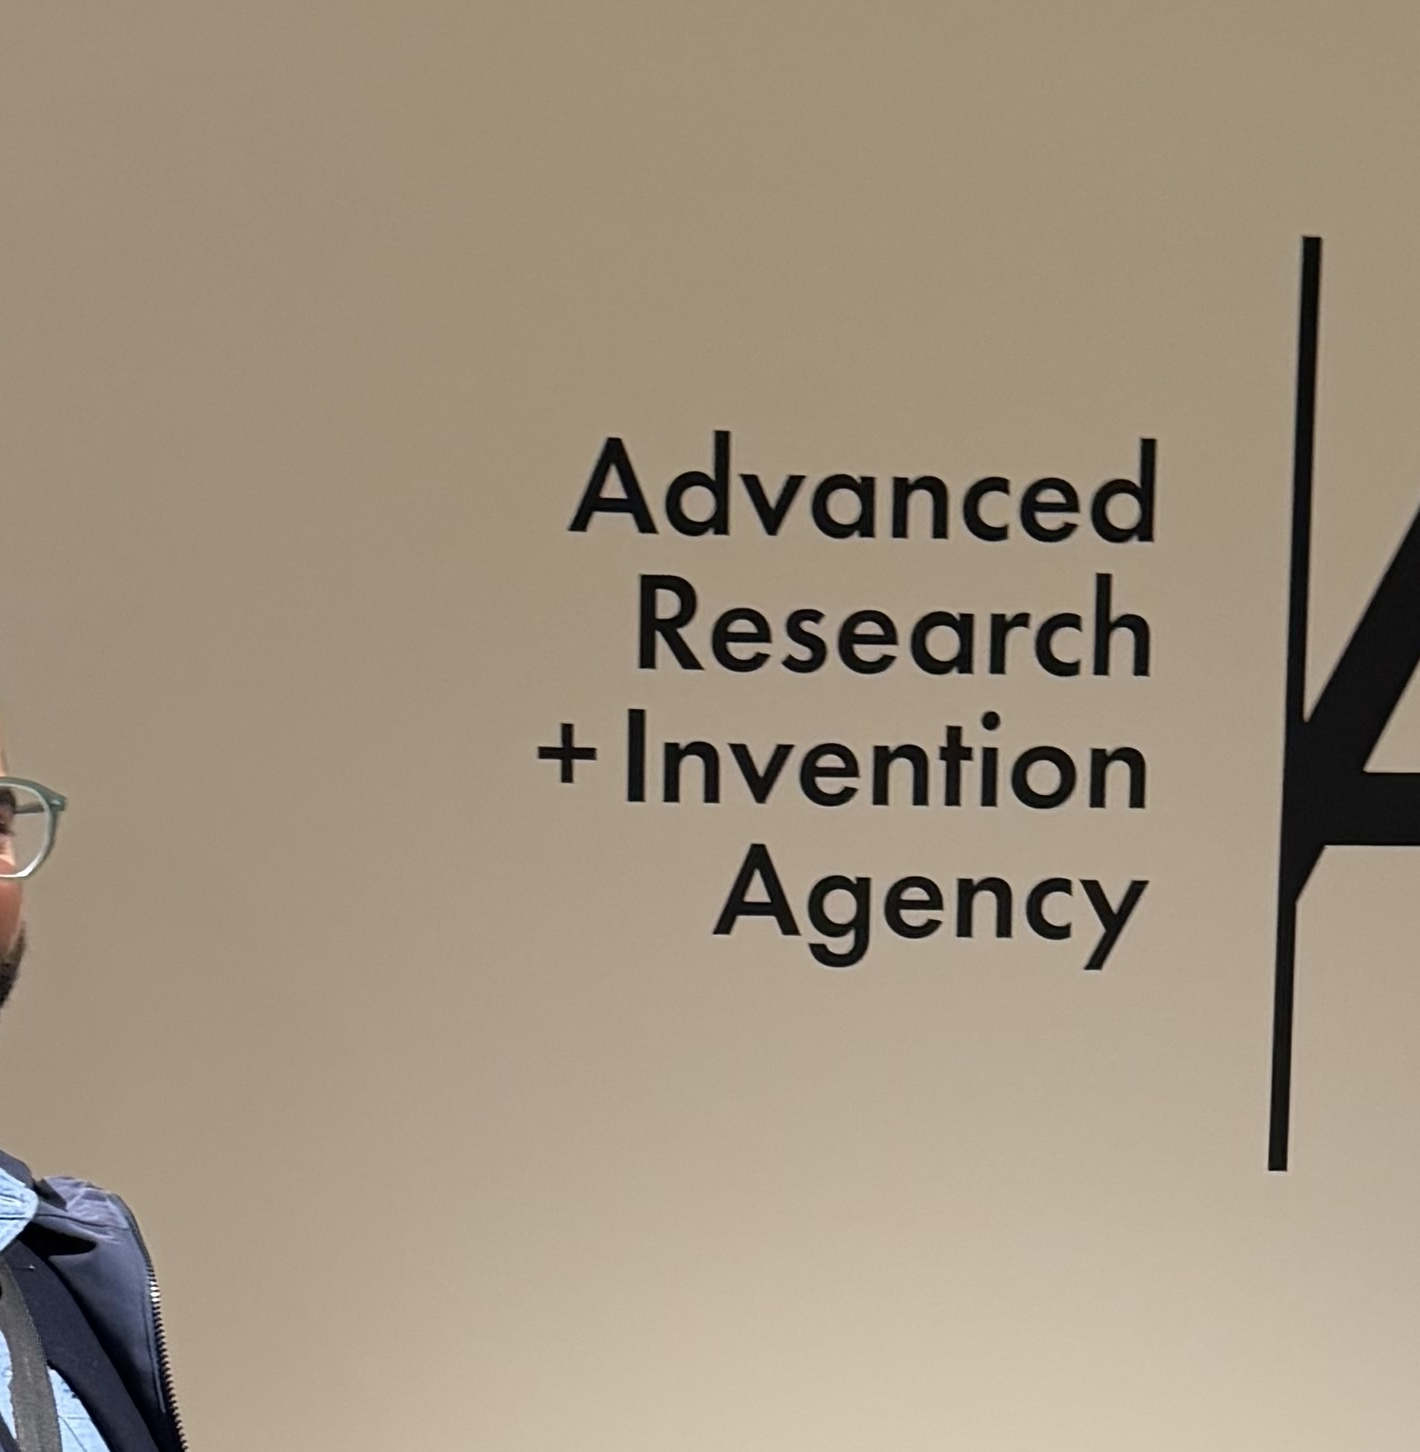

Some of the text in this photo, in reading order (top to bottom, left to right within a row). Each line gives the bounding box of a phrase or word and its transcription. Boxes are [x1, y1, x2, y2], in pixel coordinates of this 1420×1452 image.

[567, 429, 1159, 545] Advanced
[637, 571, 1153, 678] Research
[712, 842, 1151, 969] Agency
